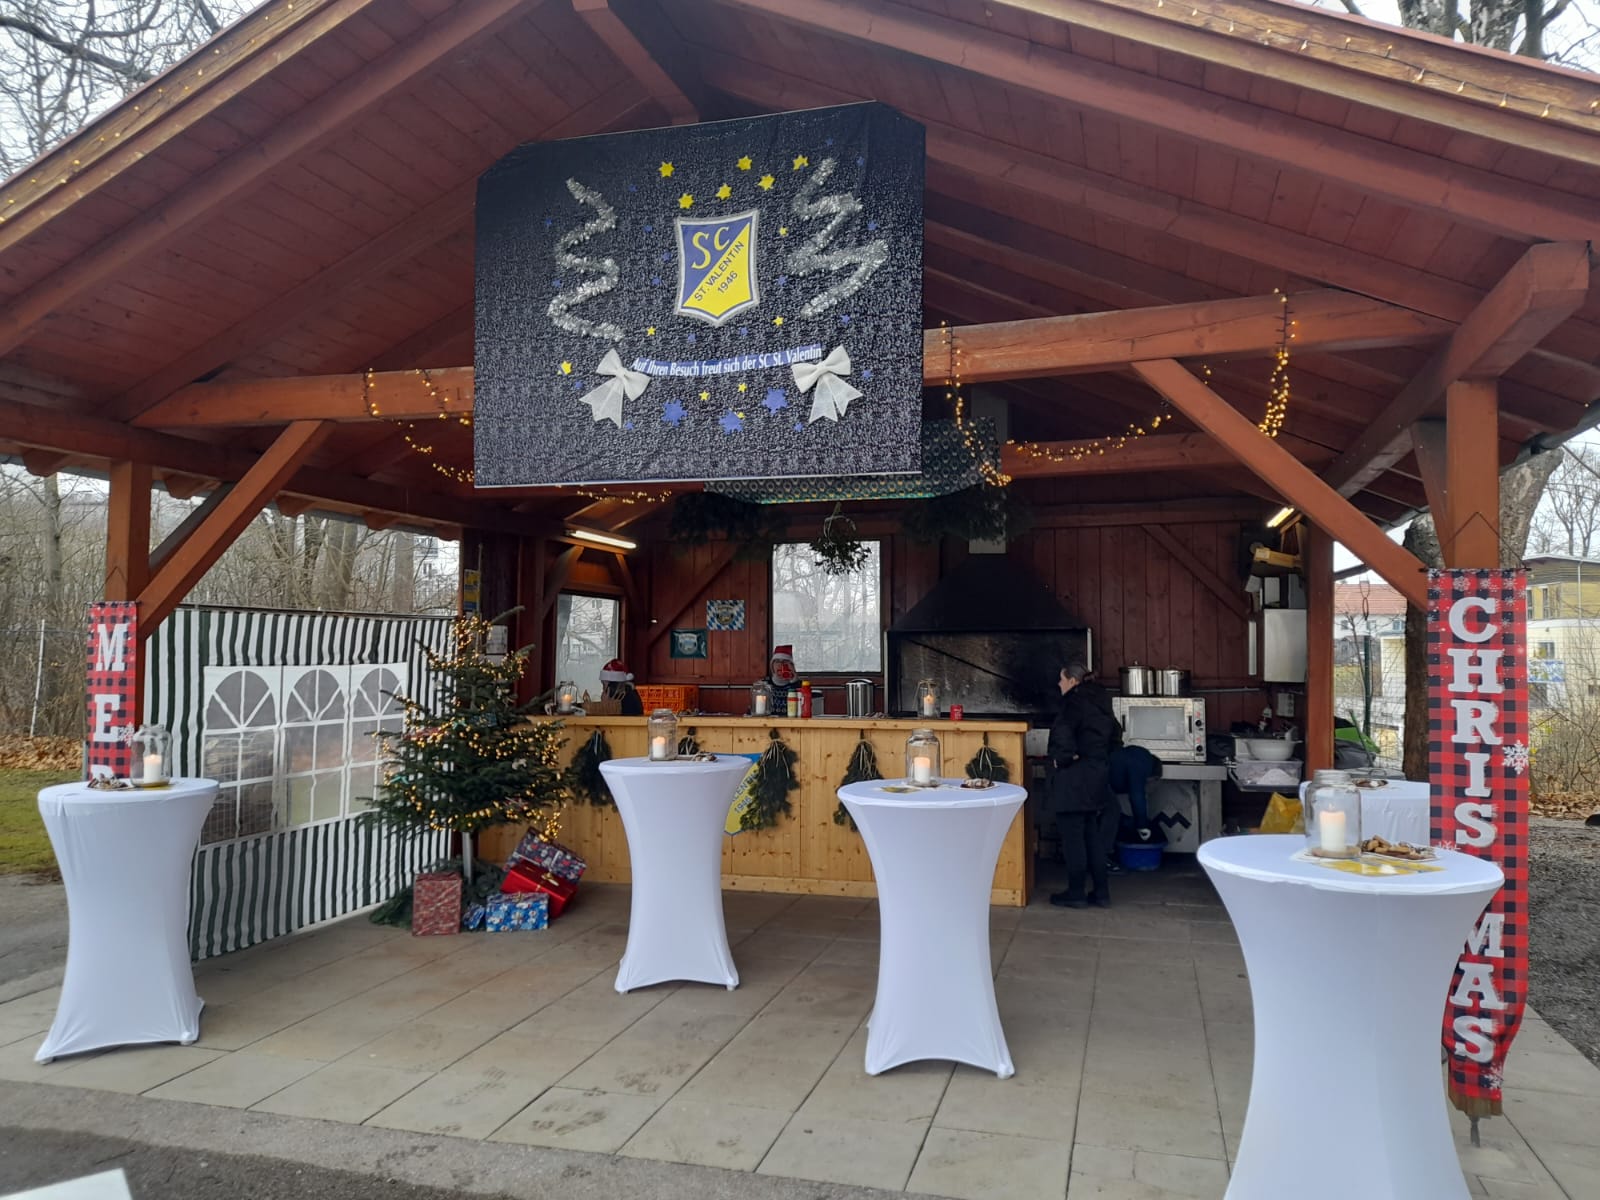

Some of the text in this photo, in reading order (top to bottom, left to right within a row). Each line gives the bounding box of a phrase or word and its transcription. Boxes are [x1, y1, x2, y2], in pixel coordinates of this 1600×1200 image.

[691, 226, 730, 270] SC
[706, 240, 745, 287] VALENTIN
[717, 270, 738, 294] 1946
[631, 357, 649, 371] Auf
[646, 359, 669, 376] Ihren
[670, 361, 700, 377] Besuch
[702, 360, 722, 376] freut
[723, 358, 740, 374] sich
[742, 356, 757, 371] der
[758, 353, 771, 369] SC
[786, 344, 822, 363] Valentin
[1446, 596, 1510, 1064] CHRISMAS
